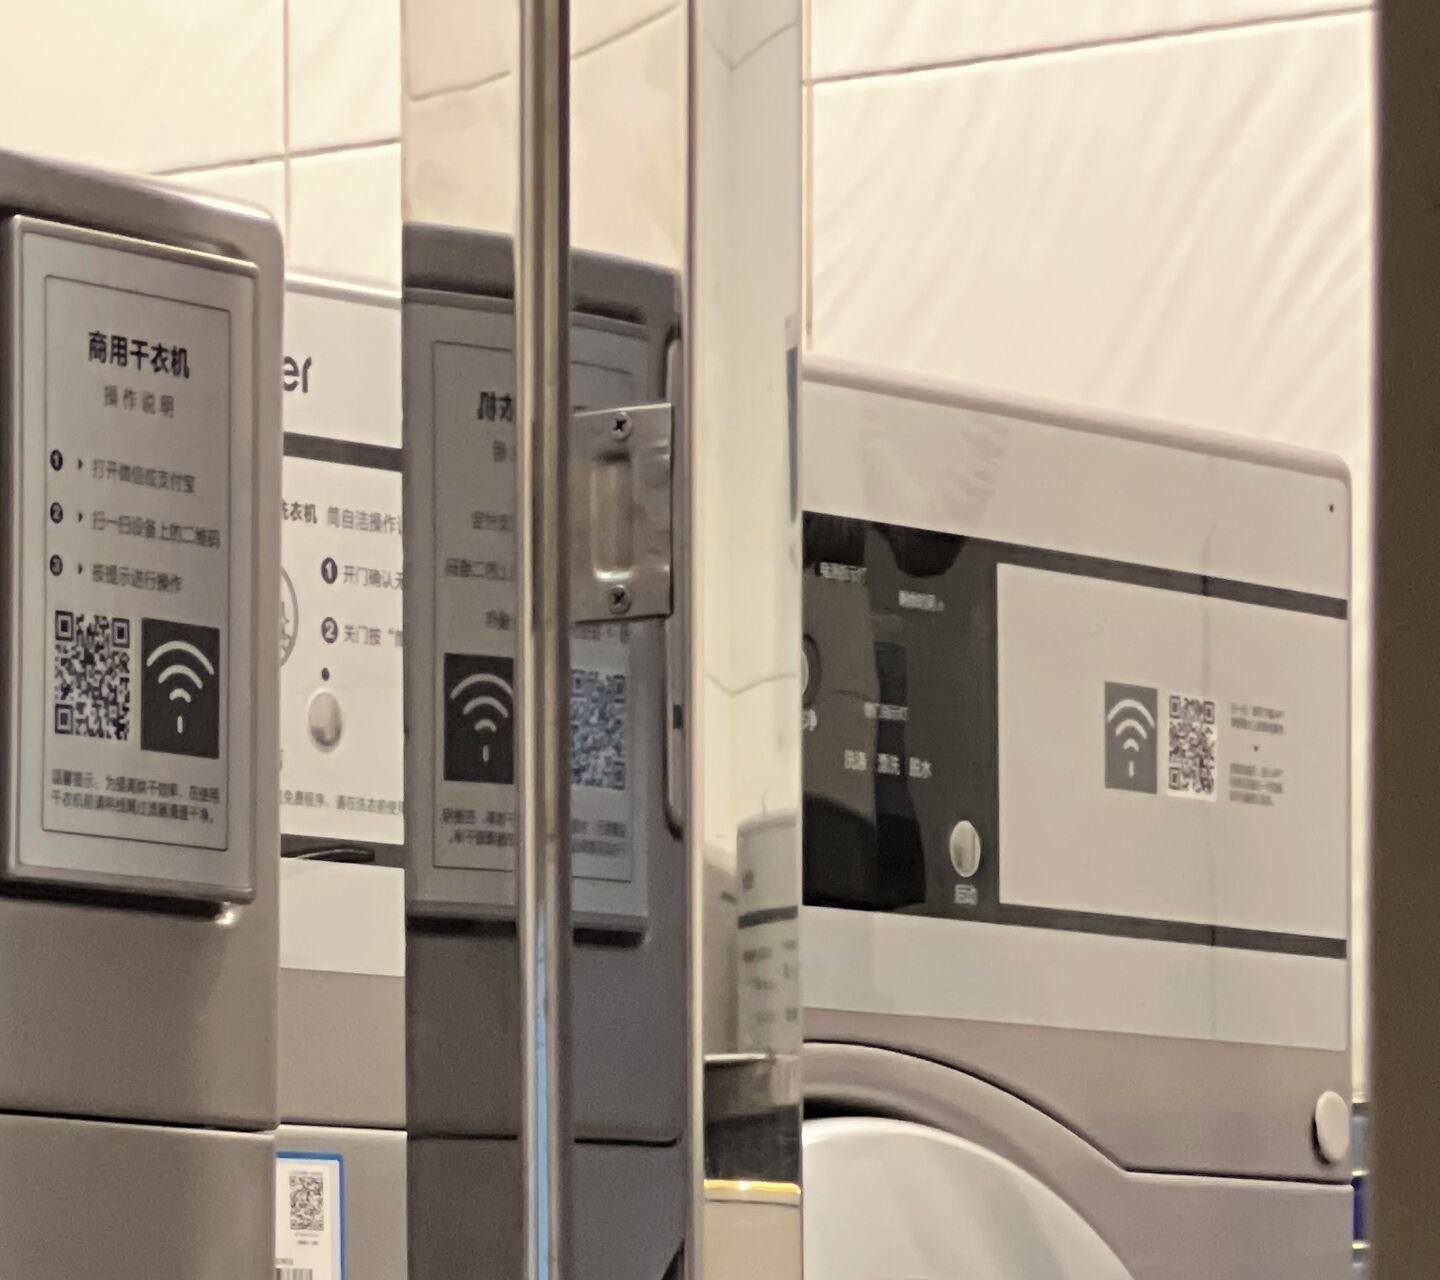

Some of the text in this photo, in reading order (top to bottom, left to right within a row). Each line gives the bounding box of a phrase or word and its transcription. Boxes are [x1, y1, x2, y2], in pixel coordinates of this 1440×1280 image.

[89, 330, 190, 379] 商用干衣机
[104, 385, 175, 418] 操作说明
